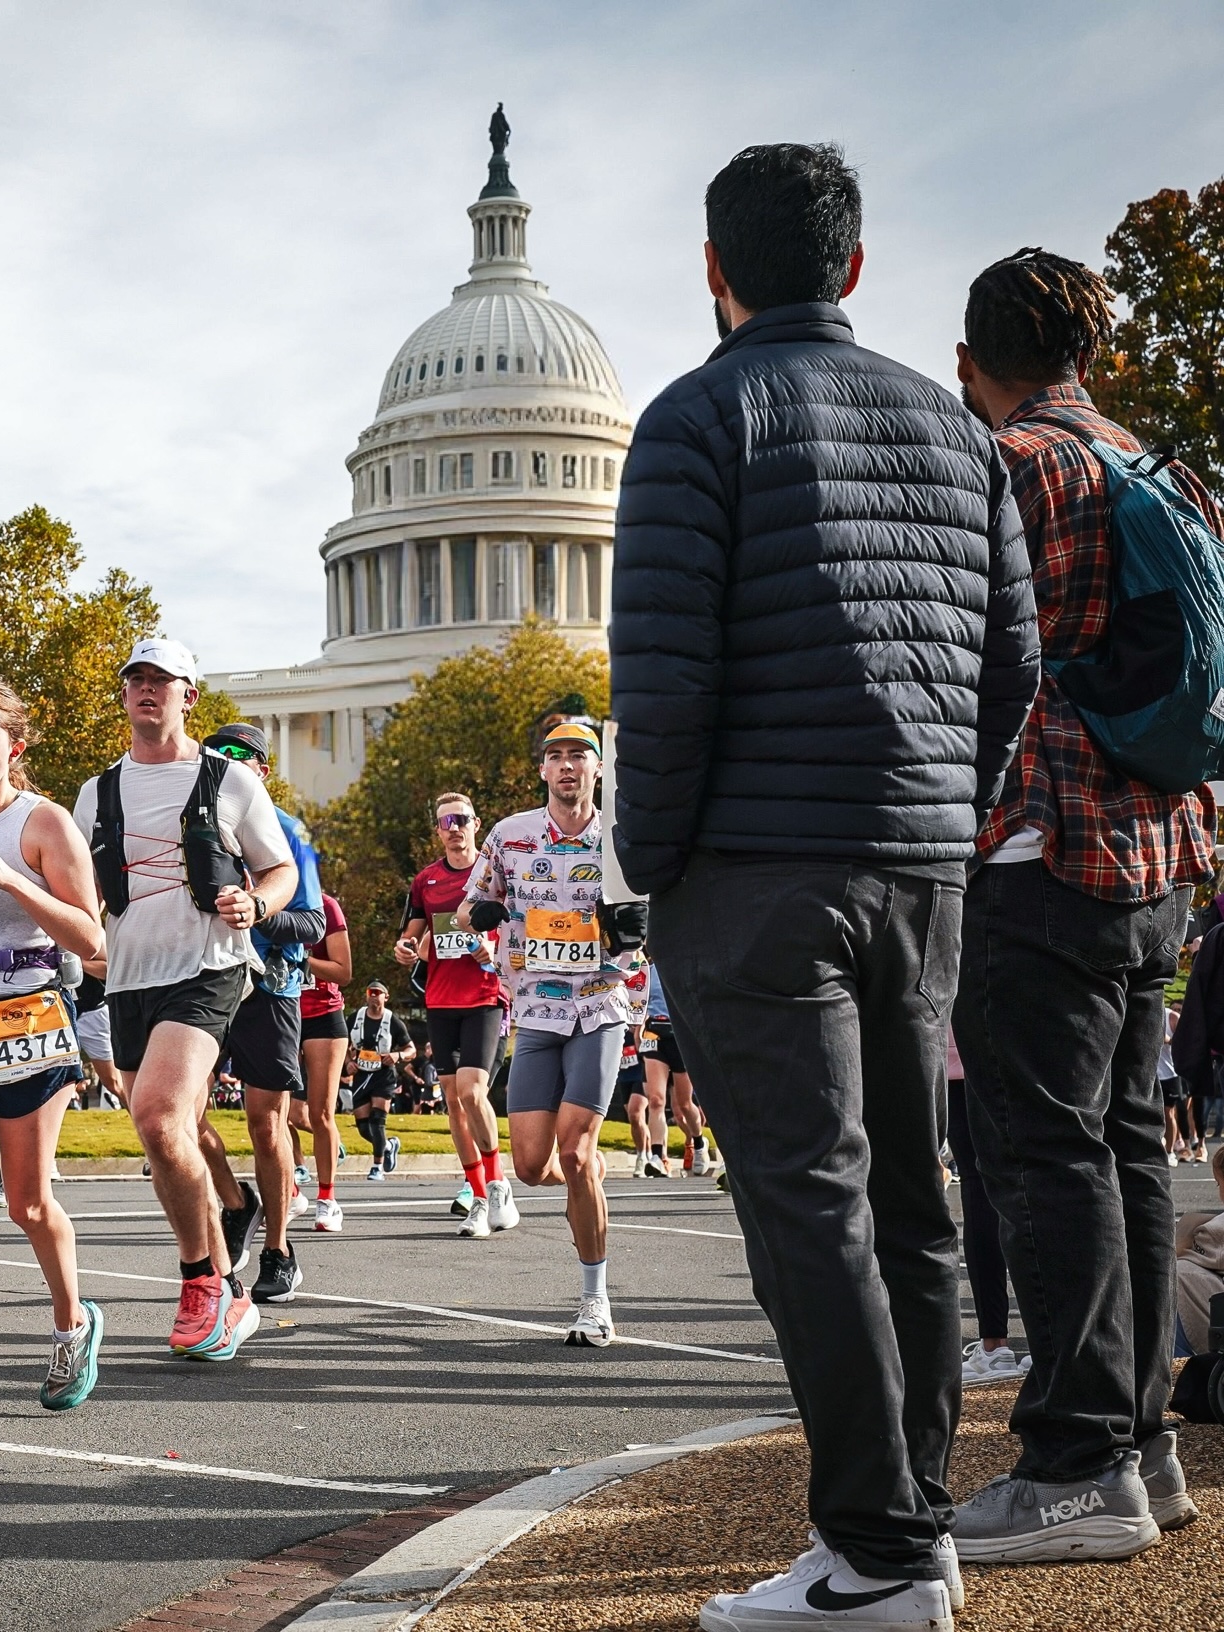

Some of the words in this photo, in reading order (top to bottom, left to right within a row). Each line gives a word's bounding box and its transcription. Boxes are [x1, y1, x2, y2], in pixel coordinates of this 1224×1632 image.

[436, 933, 484, 948] 276
[528, 939, 596, 961] 21784
[1039, 1490, 1106, 1526] HOKA
